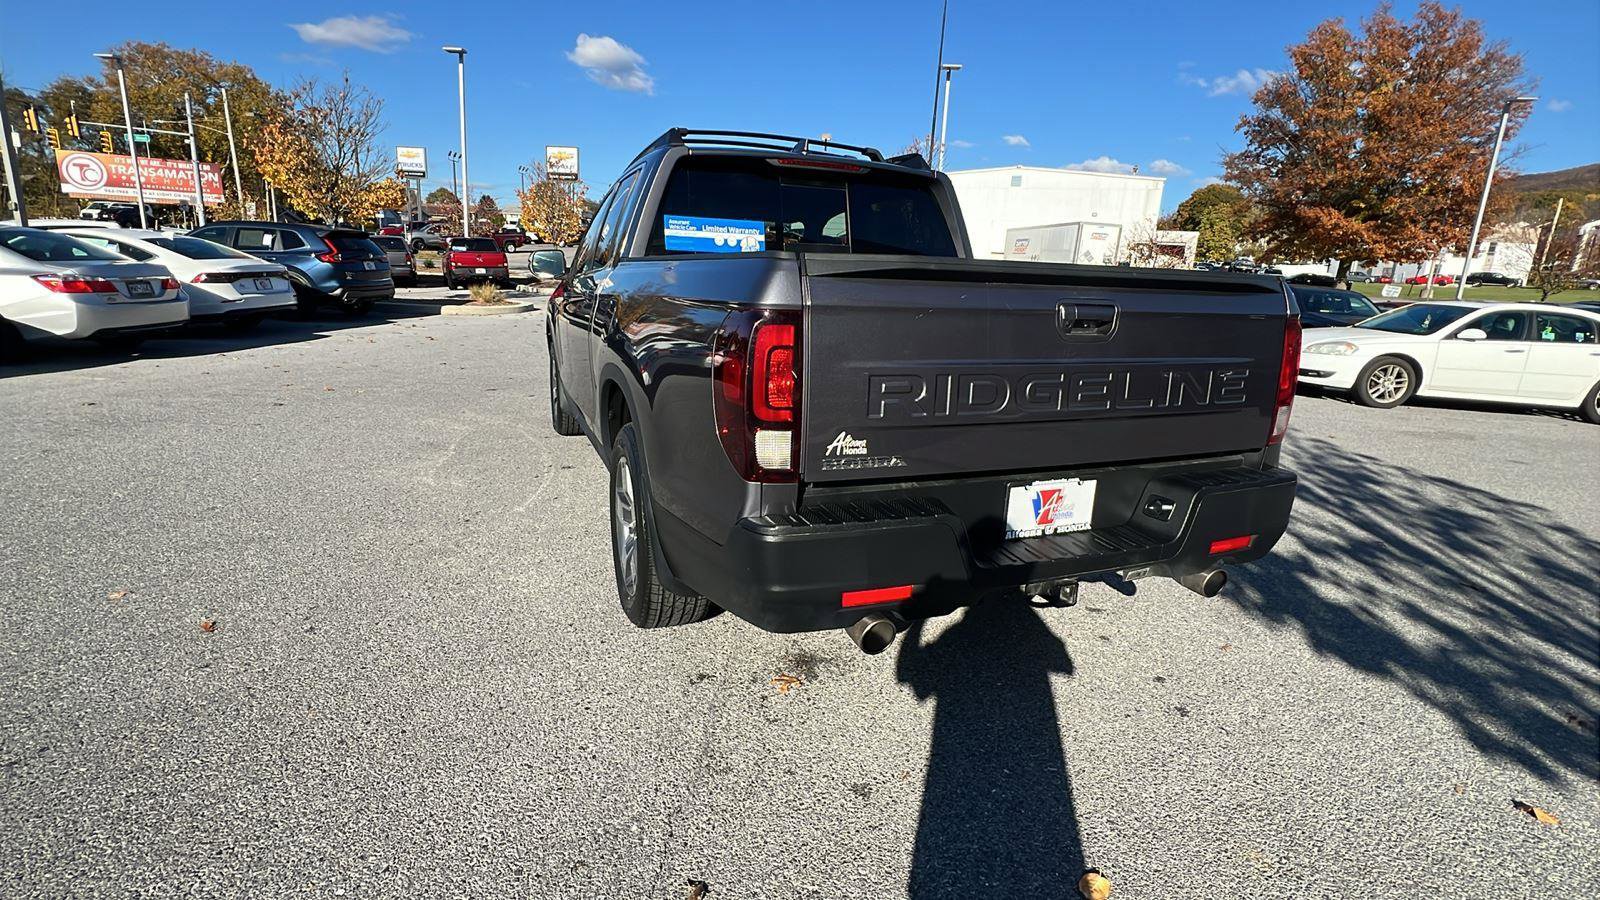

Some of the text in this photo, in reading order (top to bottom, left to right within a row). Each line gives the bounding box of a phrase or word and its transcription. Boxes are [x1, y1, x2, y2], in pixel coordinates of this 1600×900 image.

[109, 164, 219, 182] TRANS4MATON
[701, 225, 760, 235] Limited Warranty
[866, 369, 1249, 419] RIDGELINE
[843, 446, 868, 455] Honda
[821, 455, 908, 471] HONDA
